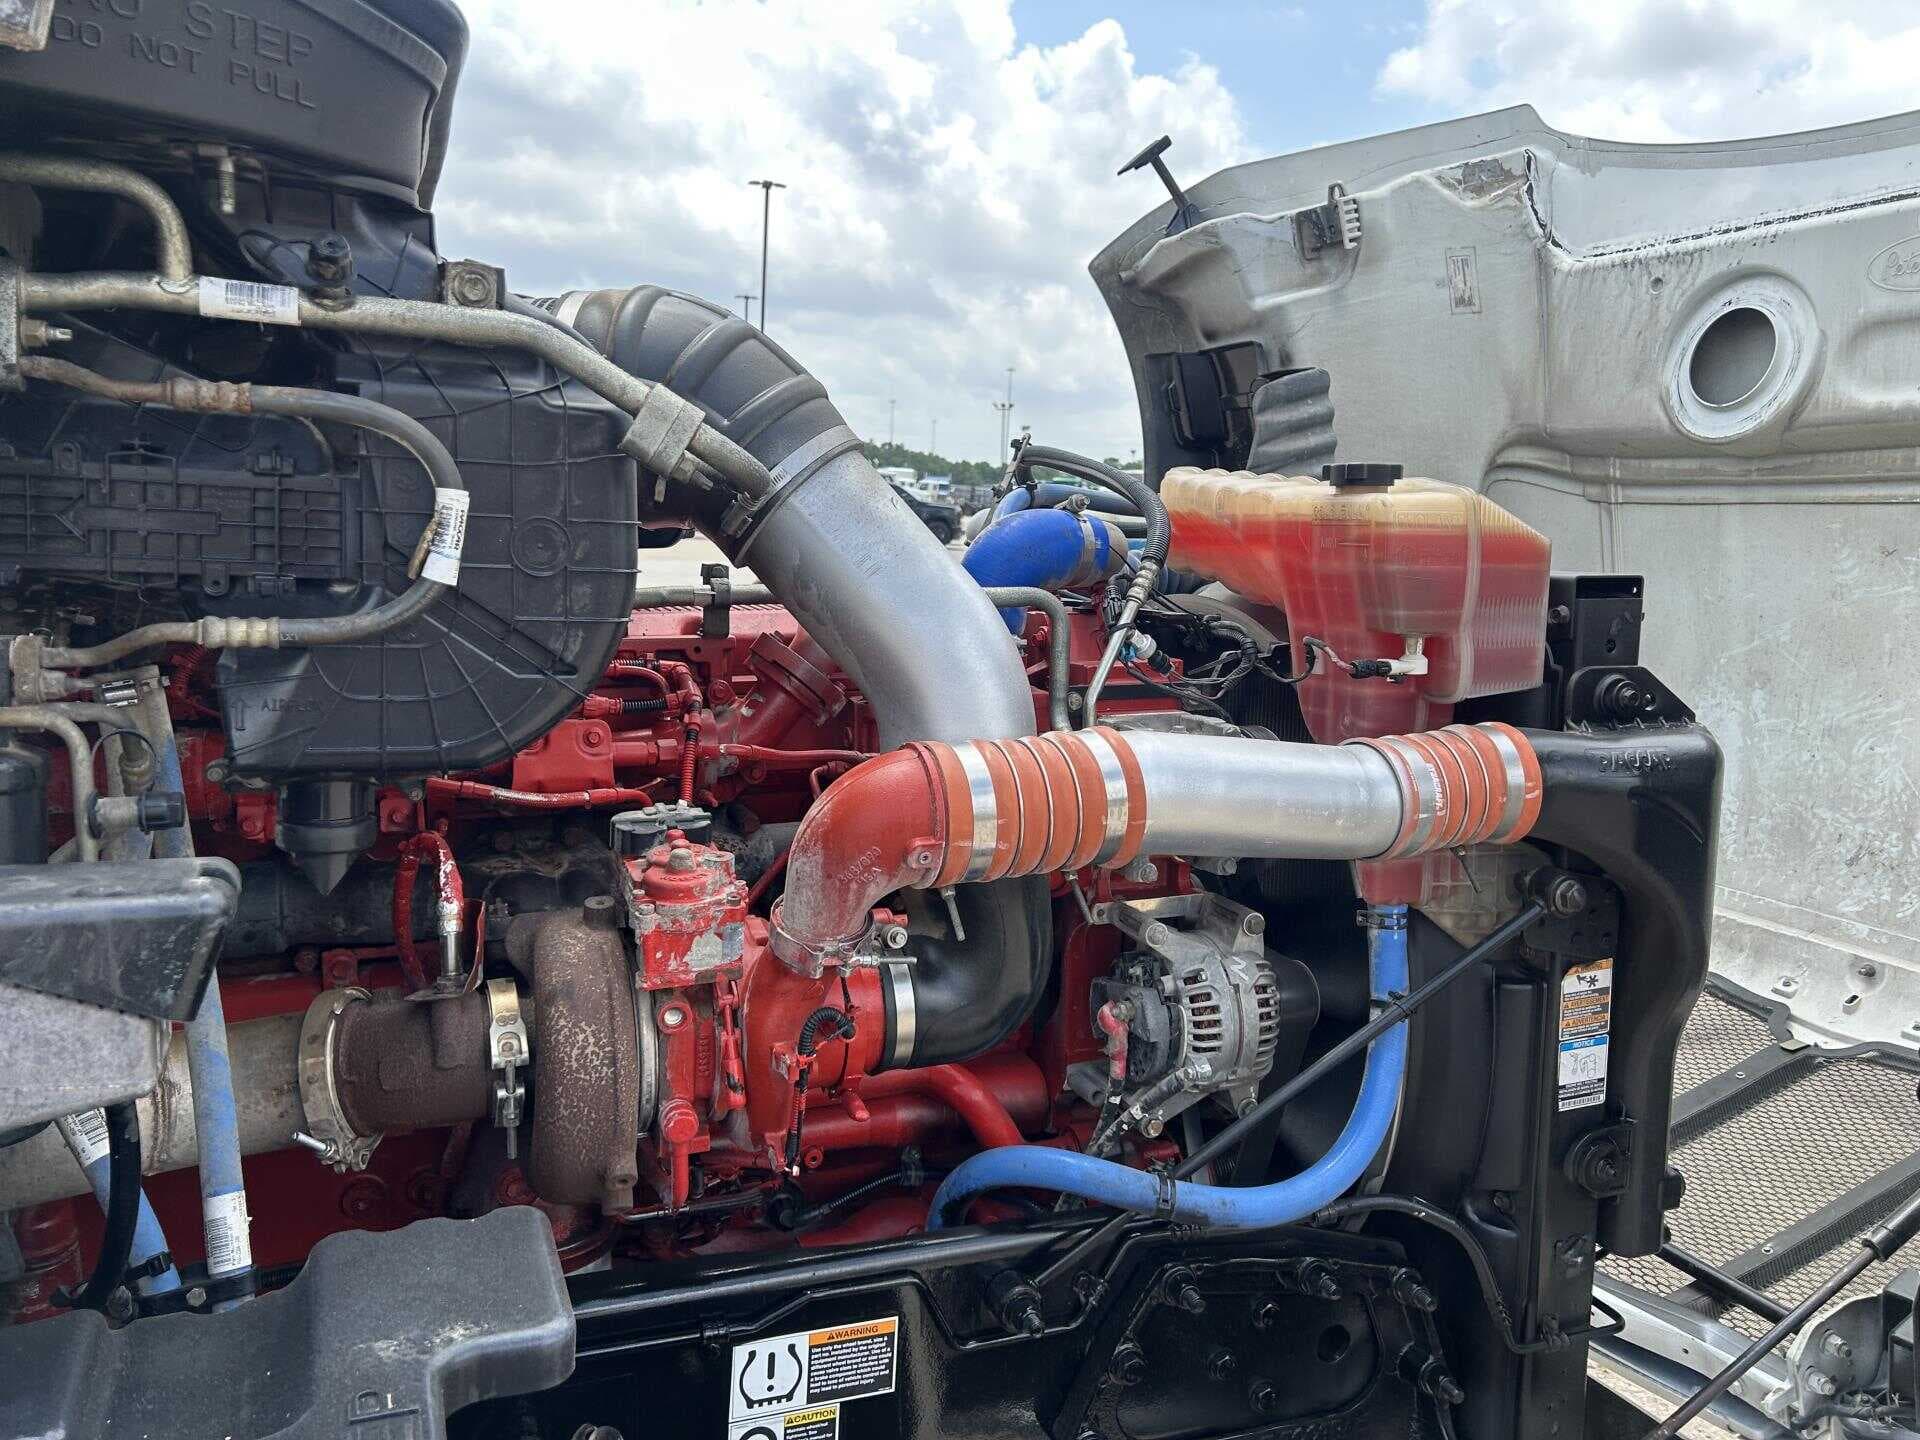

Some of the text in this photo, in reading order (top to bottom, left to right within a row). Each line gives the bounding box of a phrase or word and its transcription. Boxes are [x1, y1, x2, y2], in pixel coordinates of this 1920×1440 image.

[184, 3, 313, 66] STEP
[52, 15, 317, 110] DO NOT PULL
[835, 1326, 878, 1339] WARNING
[794, 1410, 835, 1422] CAUTION
